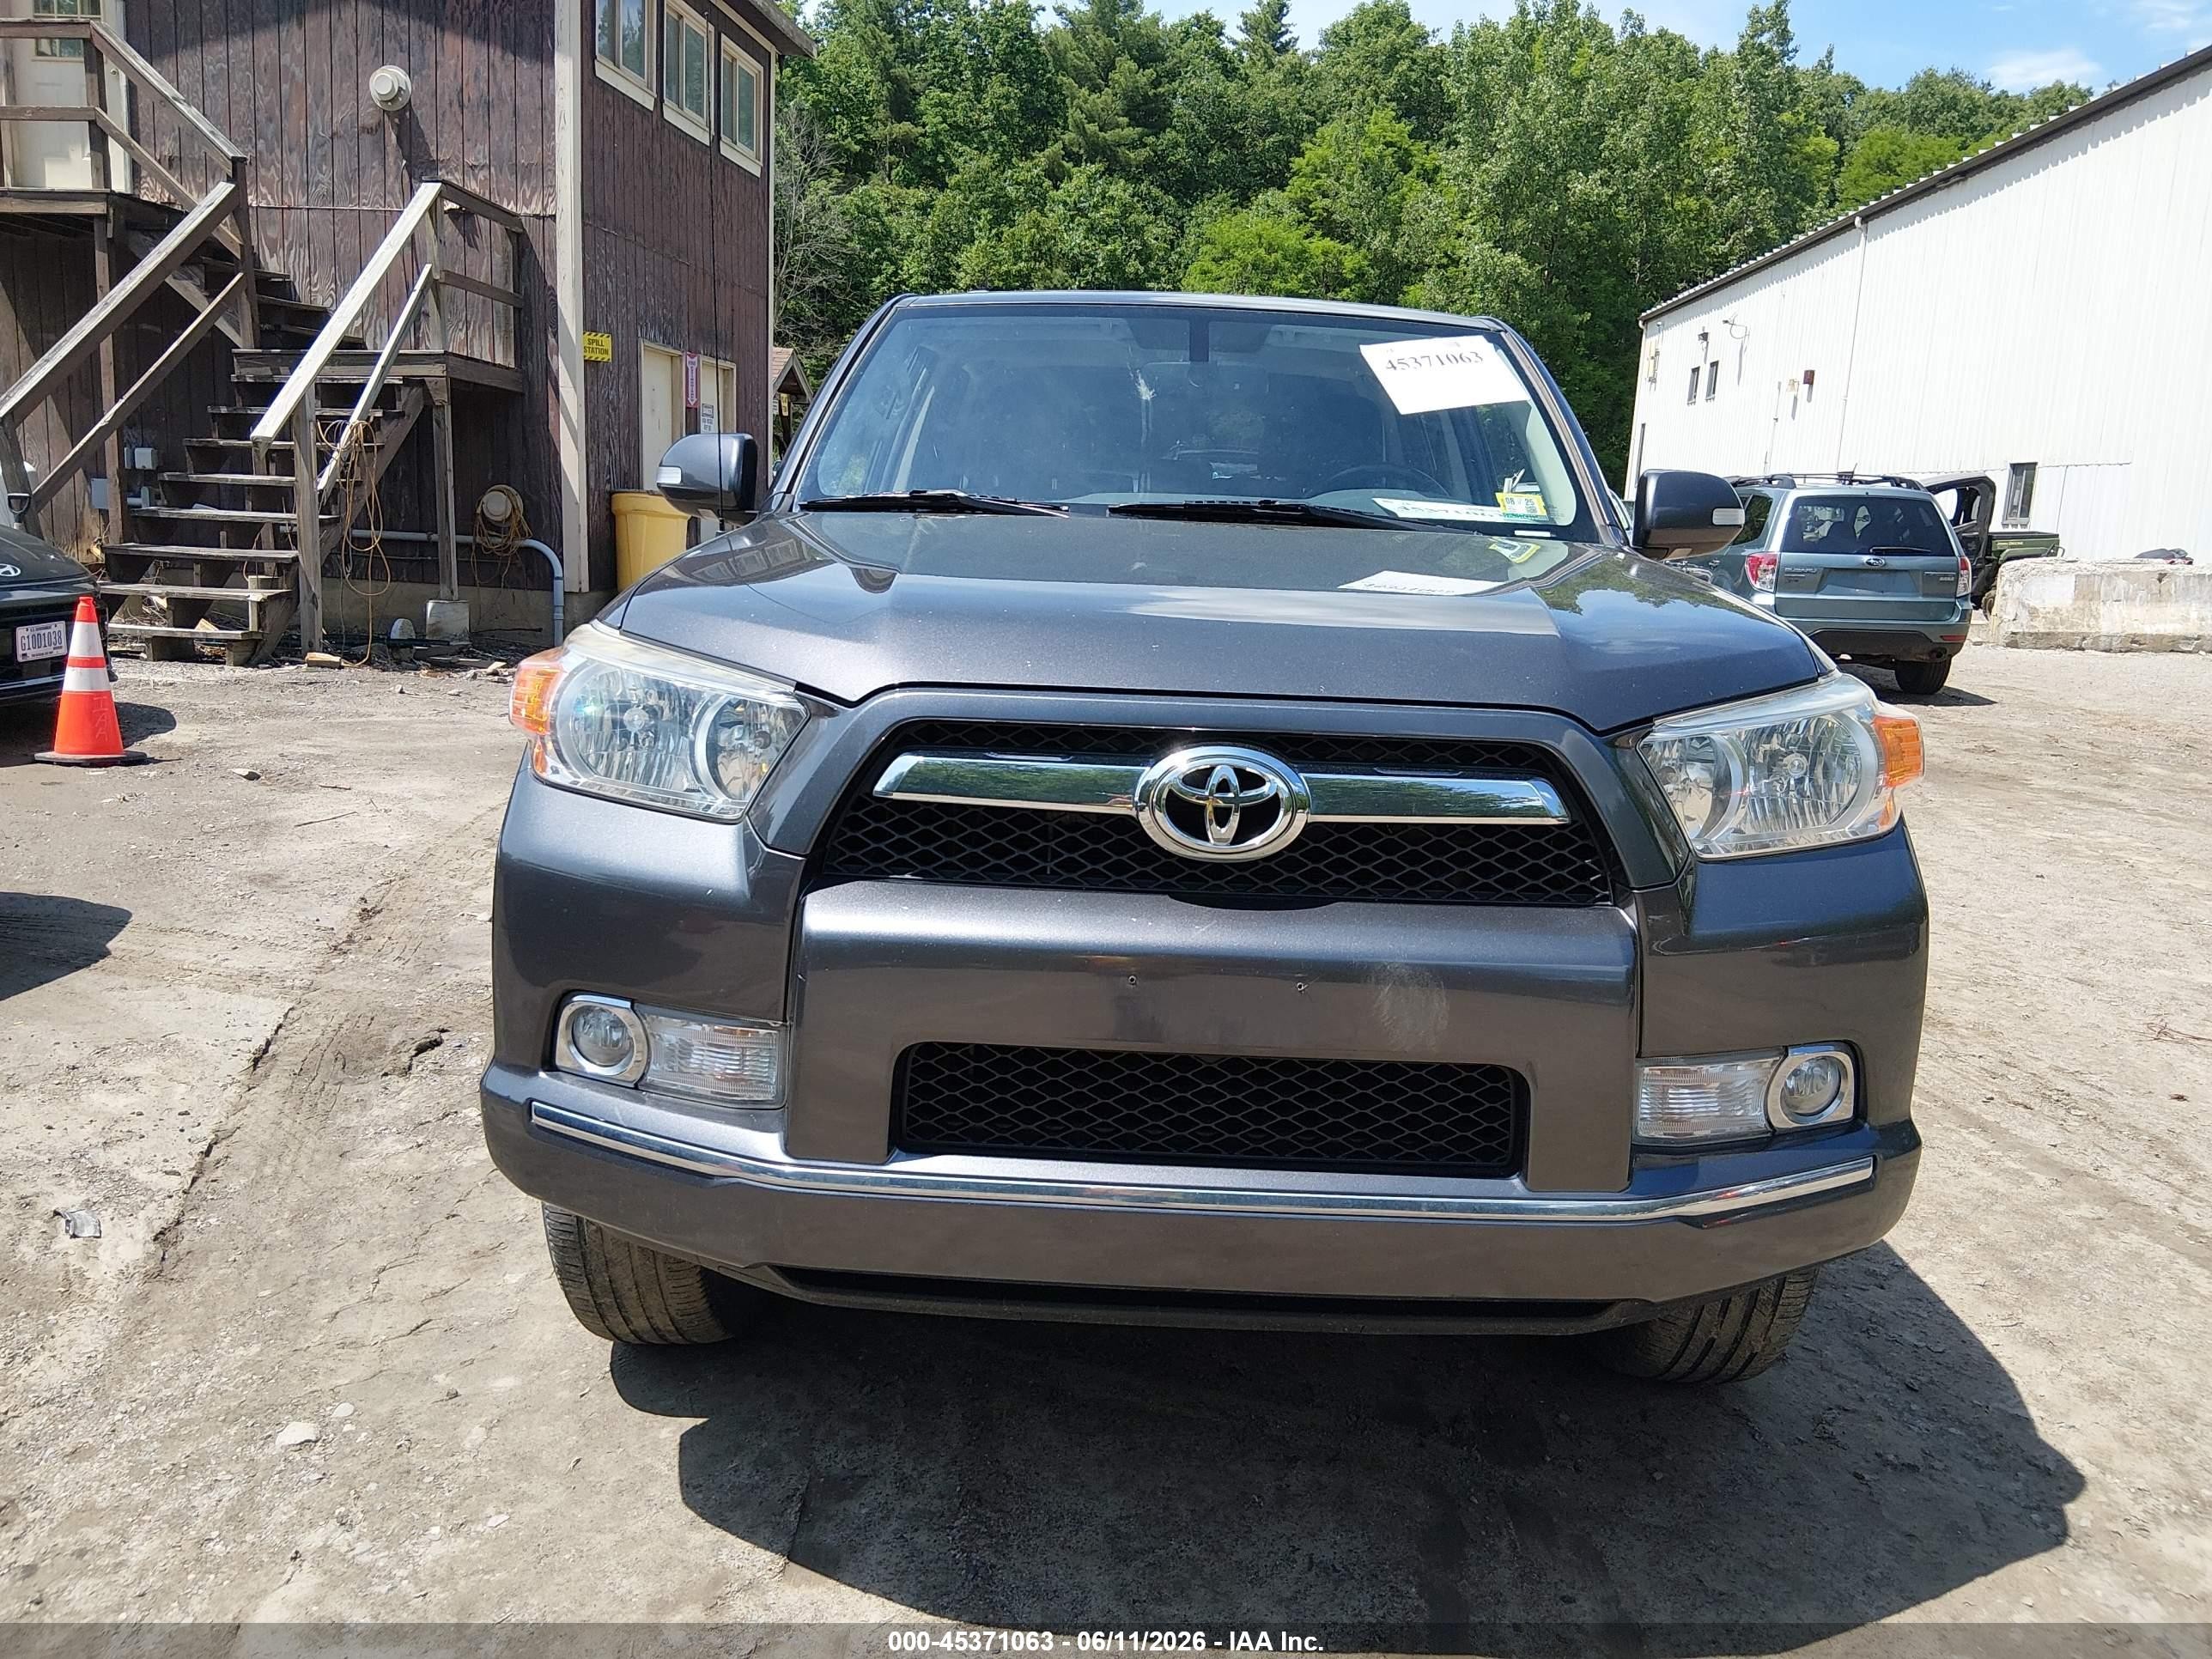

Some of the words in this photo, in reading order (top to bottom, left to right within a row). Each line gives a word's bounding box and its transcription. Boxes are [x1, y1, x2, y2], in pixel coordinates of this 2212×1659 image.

[587, 338, 605, 347] SPILL
[584, 346, 609, 356] STATION
[1386, 350, 1484, 371] 45371063
